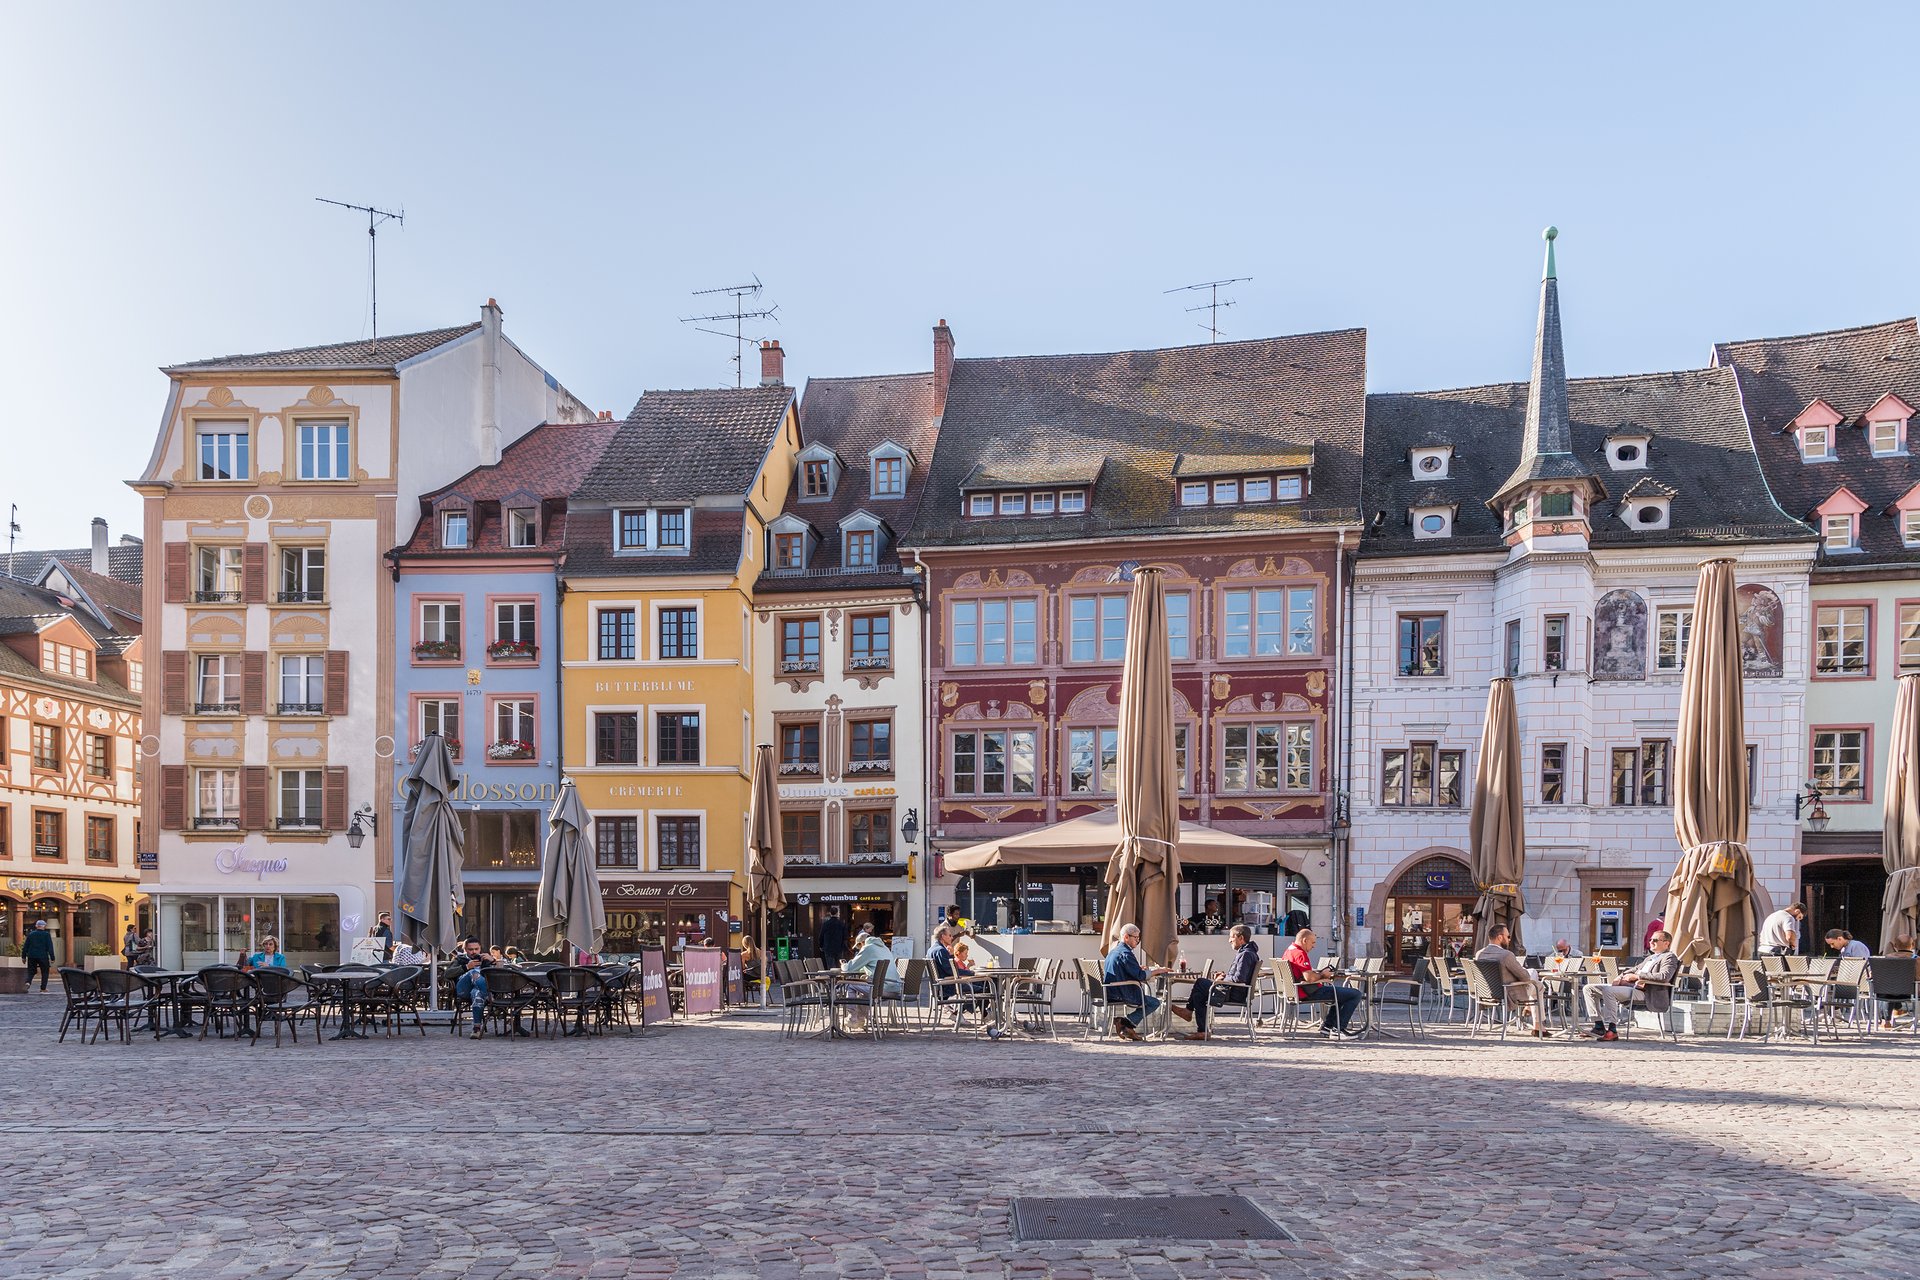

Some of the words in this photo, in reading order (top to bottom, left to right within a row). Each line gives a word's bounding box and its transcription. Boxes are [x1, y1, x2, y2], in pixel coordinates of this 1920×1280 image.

[595, 680, 695, 692] BUTTERBLUME
[609, 783, 683, 796] CRÊMERIE
[778, 787, 848, 798] olumbus
[214, 845, 288, 881] Jacques
[7, 878, 67, 893] GUILLAUME
[69, 880, 91, 894] TELL
[616, 884, 662, 896] Bouton
[667, 883, 698, 896] d'Or
[607, 913, 637, 930] 110
